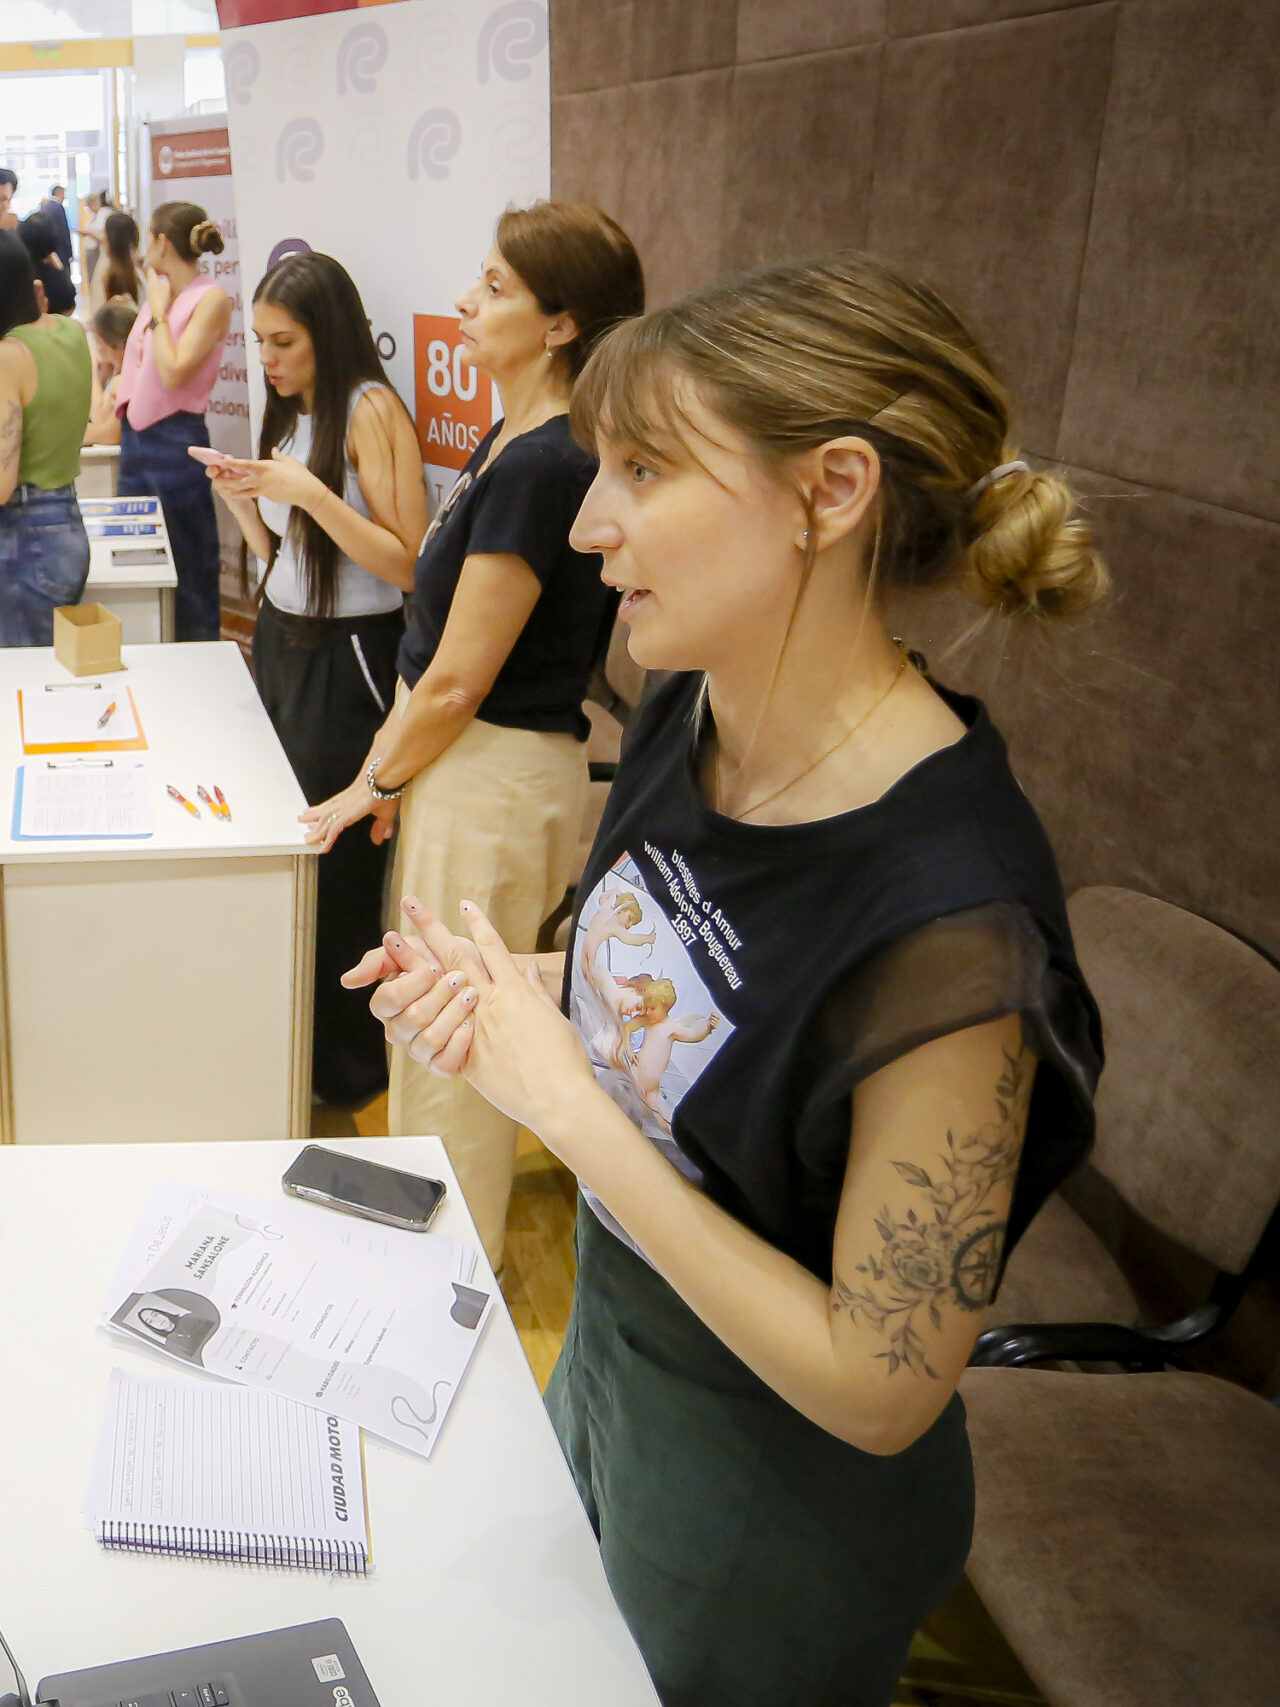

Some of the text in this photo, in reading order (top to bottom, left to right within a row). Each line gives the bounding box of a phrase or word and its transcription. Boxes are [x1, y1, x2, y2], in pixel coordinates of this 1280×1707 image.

[427, 340, 478, 402] 80
[427, 411, 480, 453] AÑOS
[644, 841, 743, 991] william Adolphe Bouguereau
[671, 849, 743, 951] blessures d Amour
[671, 912, 697, 947] 1897
[184, 1235, 216, 1270] MARIANA
[193, 1235, 230, 1280] SANSALONE
[326, 1416, 349, 1522] CIUDAD MOTO
